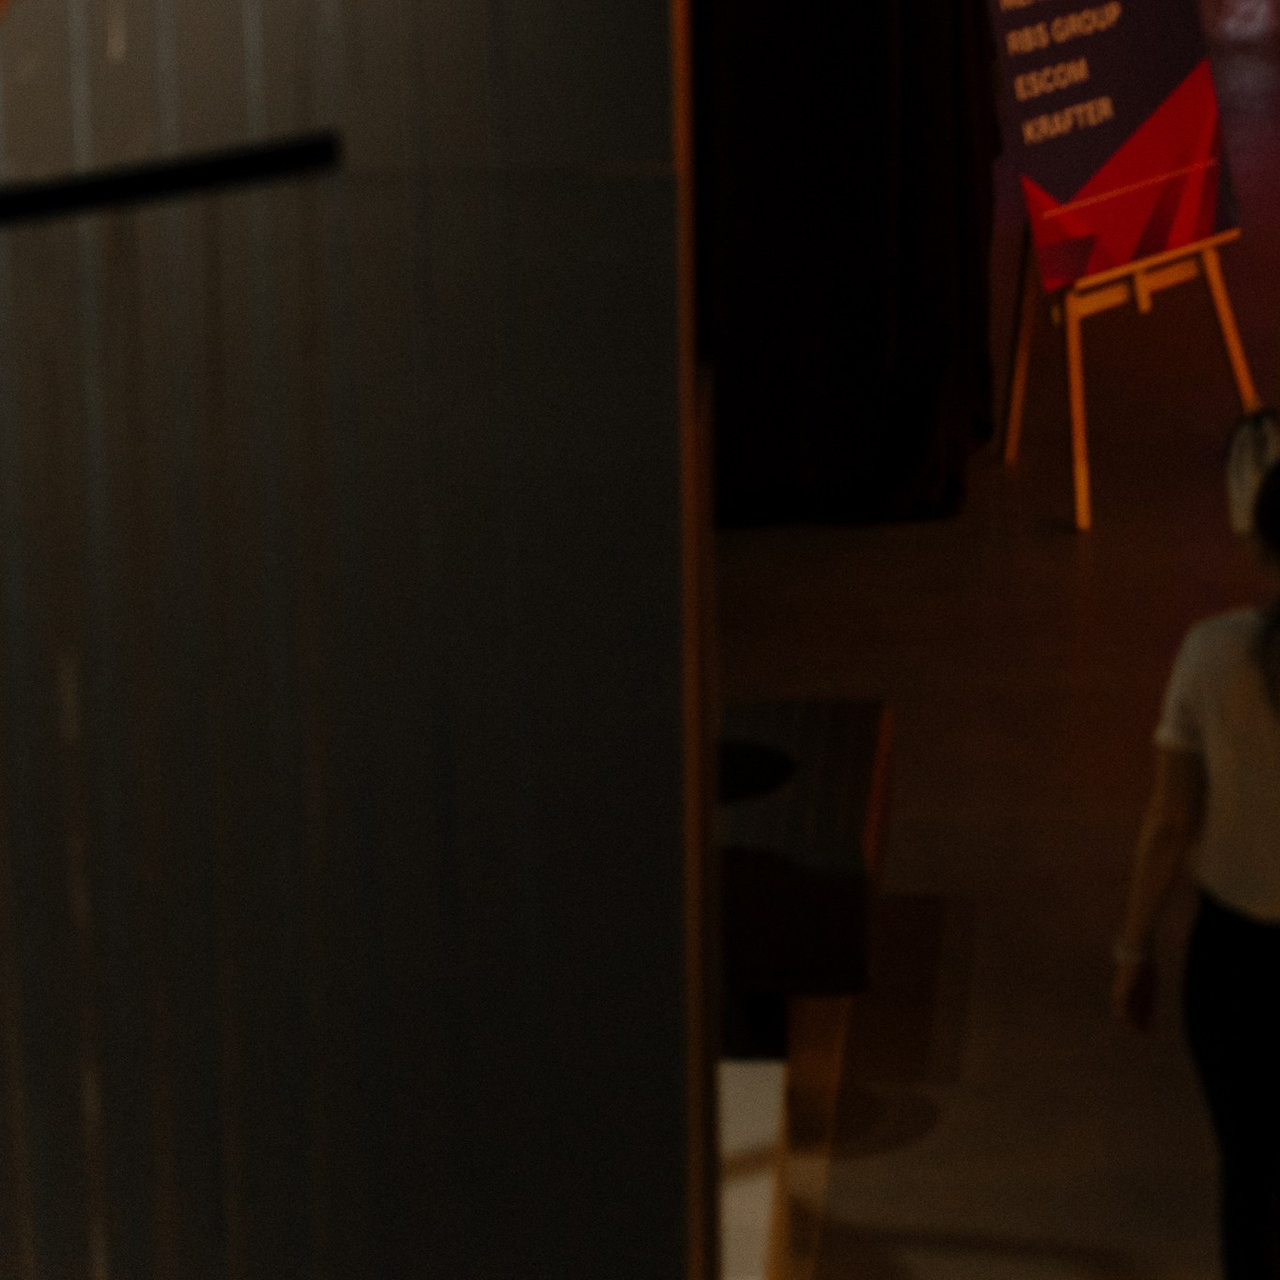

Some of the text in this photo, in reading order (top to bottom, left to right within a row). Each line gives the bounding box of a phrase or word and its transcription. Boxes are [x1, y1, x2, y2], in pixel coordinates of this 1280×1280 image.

[1051, 0, 1123, 44] GROUP
[1014, 55, 1091, 103] ESCOM
[1022, 94, 1116, 147] KRAFTER
